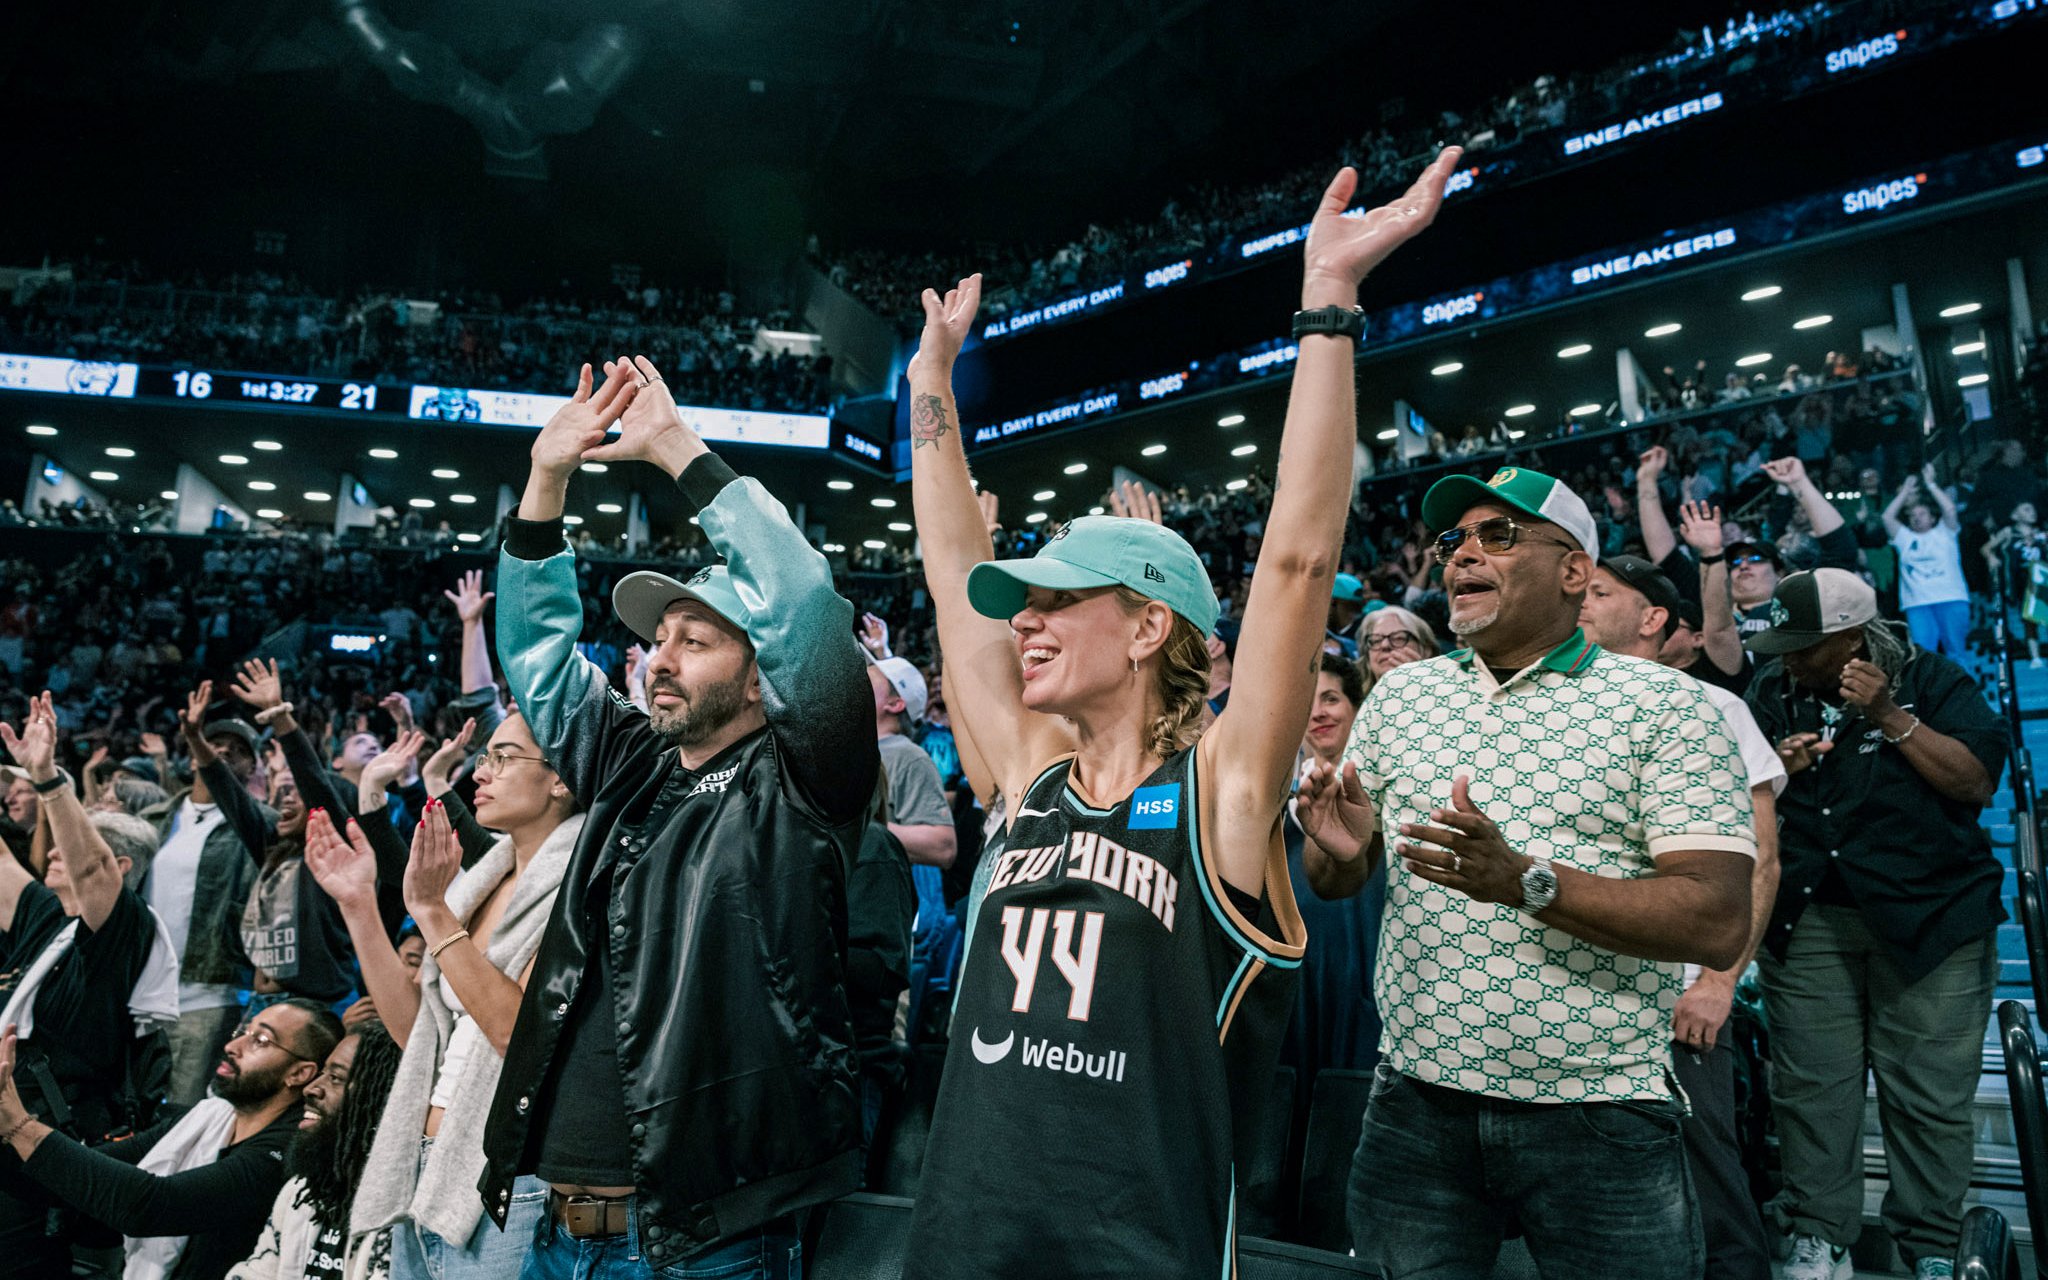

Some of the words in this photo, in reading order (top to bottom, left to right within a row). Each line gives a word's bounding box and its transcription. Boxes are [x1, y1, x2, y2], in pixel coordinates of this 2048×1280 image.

[1826, 33, 1899, 72] snipes
[1564, 92, 1724, 155] SNEAKERS
[1445, 169, 1473, 198] pes
[1842, 176, 1919, 214] snipes
[1571, 228, 1736, 285] SNEAKERS
[984, 321, 1008, 339] ALL
[1010, 309, 1042, 331] DAY!
[1043, 295, 1089, 320] EVERY
[1089, 283, 1124, 306] DAY!
[1422, 294, 1478, 326] snipes
[172, 370, 213, 399] 16
[241, 381, 268, 398] 1st
[269, 381, 319, 403] 3:27
[339, 383, 377, 411] 21
[975, 425, 1000, 443] ALL
[1002, 415, 1035, 435] DAY!
[1036, 403, 1082, 427] EVERY
[1083, 392, 1118, 414] DAY!
[1135, 798, 1174, 815] HSS
[1066, 830, 1179, 933] YORK
[1000, 905, 1105, 1022] 44
[1021, 1036, 1127, 1083] Webull
